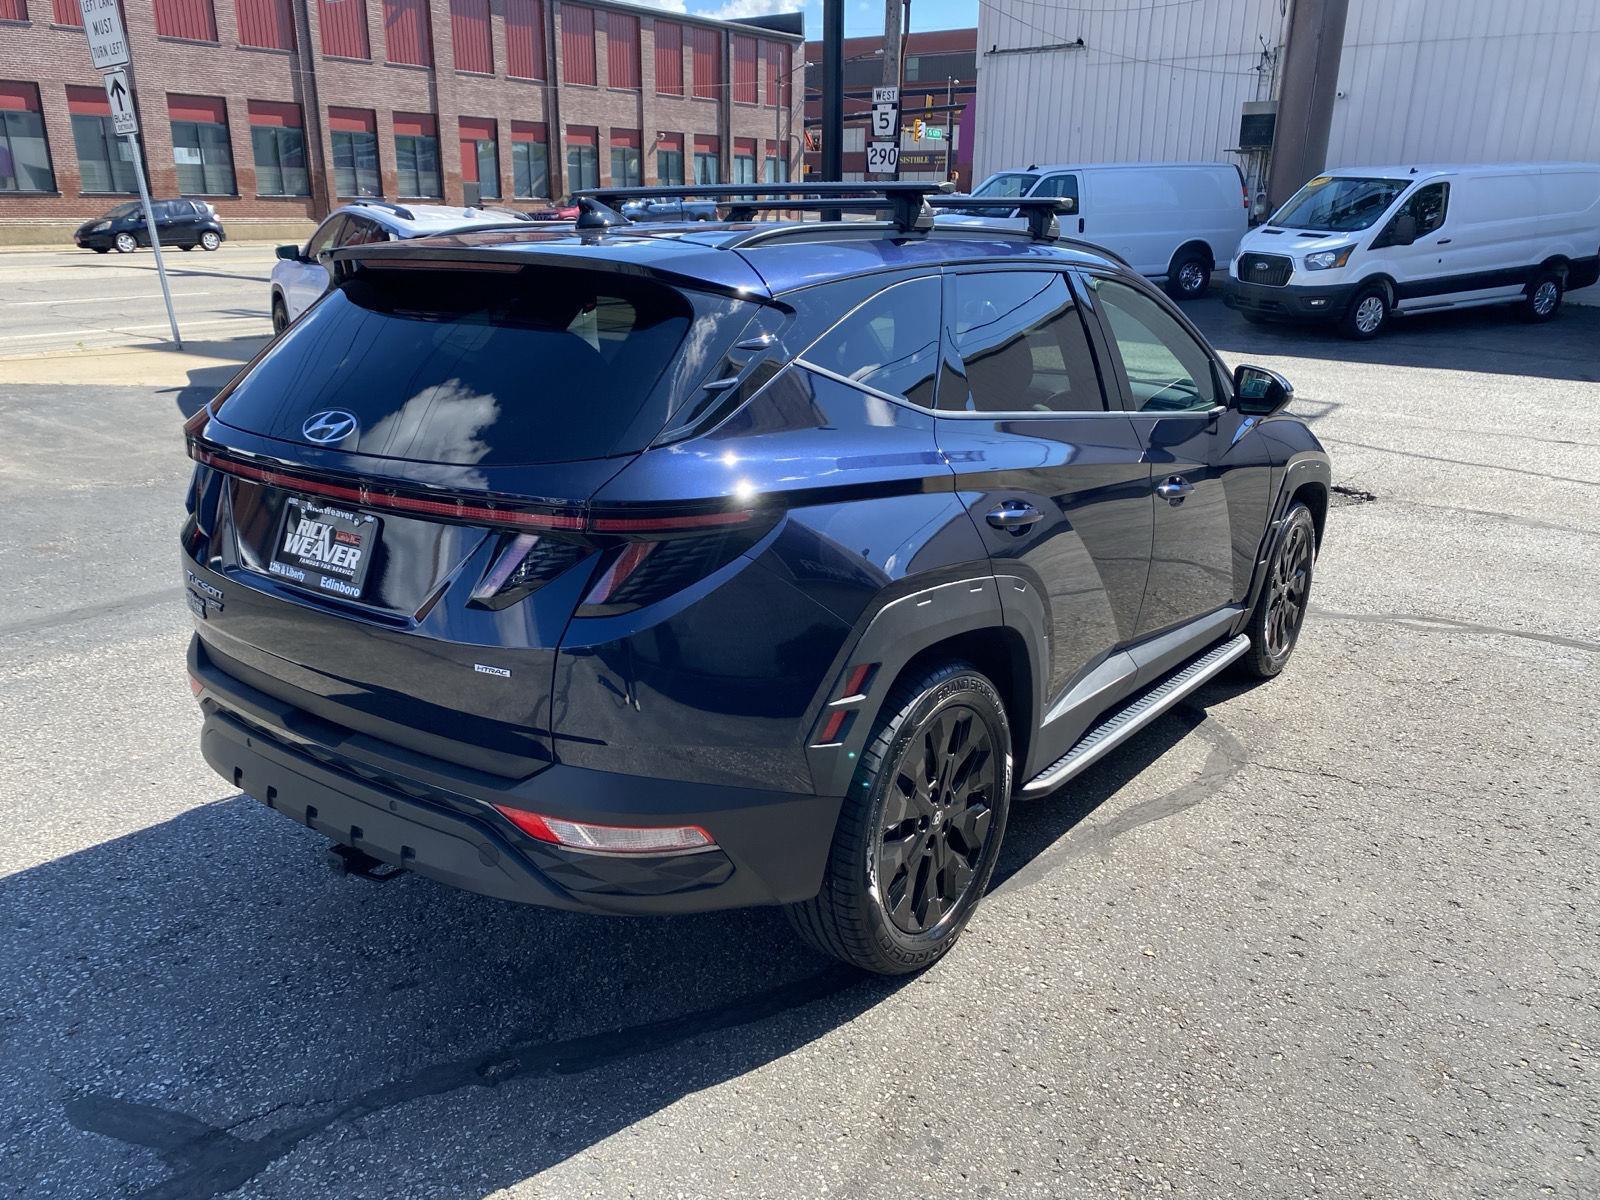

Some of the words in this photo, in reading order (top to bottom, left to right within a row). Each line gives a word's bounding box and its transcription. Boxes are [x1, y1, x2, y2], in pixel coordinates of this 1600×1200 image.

[92, 17, 113, 36] MUST
[92, 45, 109, 59] TURN
[110, 41, 125, 56] LEFT
[875, 90, 896, 101] WEST
[114, 112, 134, 123] BLACK
[879, 112, 890, 130] 5
[869, 148, 897, 166] 290
[324, 507, 354, 520] Weaver
[296, 519, 334, 541] RICK
[283, 532, 362, 570] WEAVER
[286, 567, 305, 582] Liberty
[299, 558, 319, 567] FAMOUS
[320, 563, 332, 571] FOR
[332, 565, 355, 576] SERVICE
[320, 576, 360, 597] Edinboro
[476, 665, 508, 676] HTRAC
